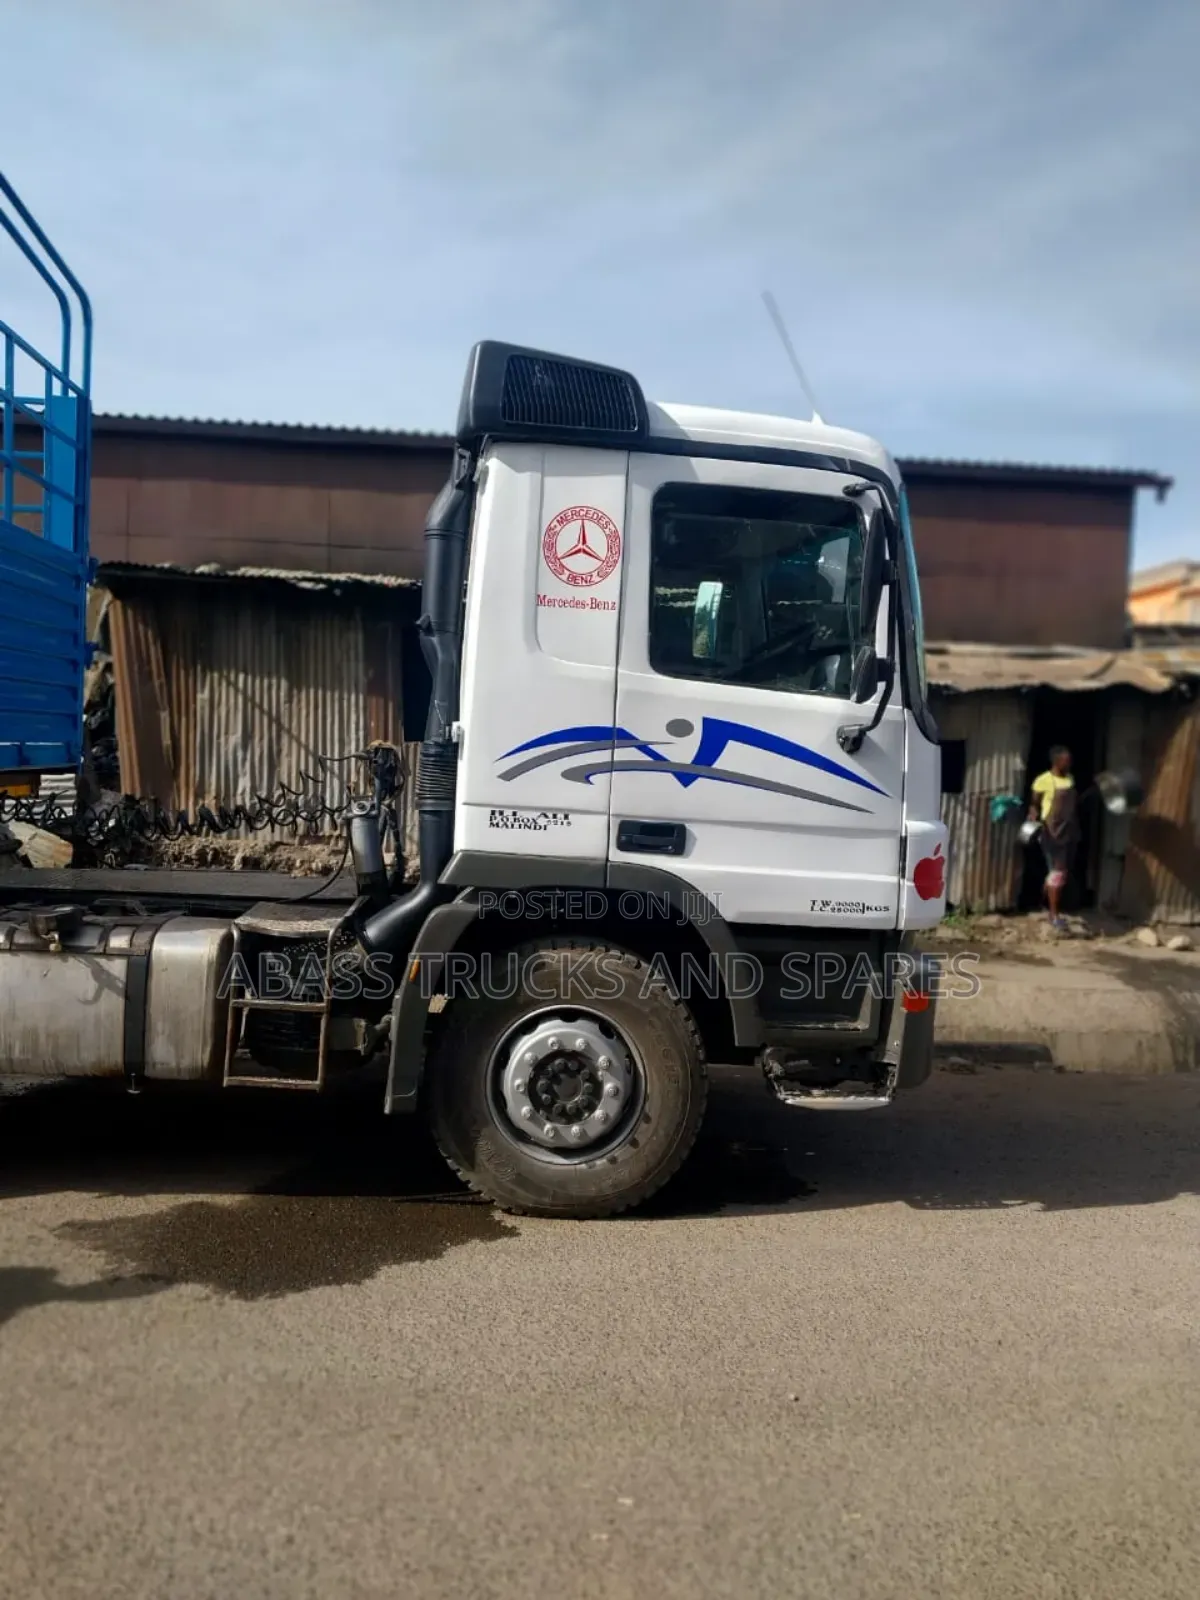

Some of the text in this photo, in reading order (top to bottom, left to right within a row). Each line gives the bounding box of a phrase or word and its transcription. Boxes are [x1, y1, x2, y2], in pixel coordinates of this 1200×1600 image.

[567, 574, 596, 584] BENZ
[536, 594, 616, 610] Mercedes-Benz
[489, 821, 547, 831] MALINDI
